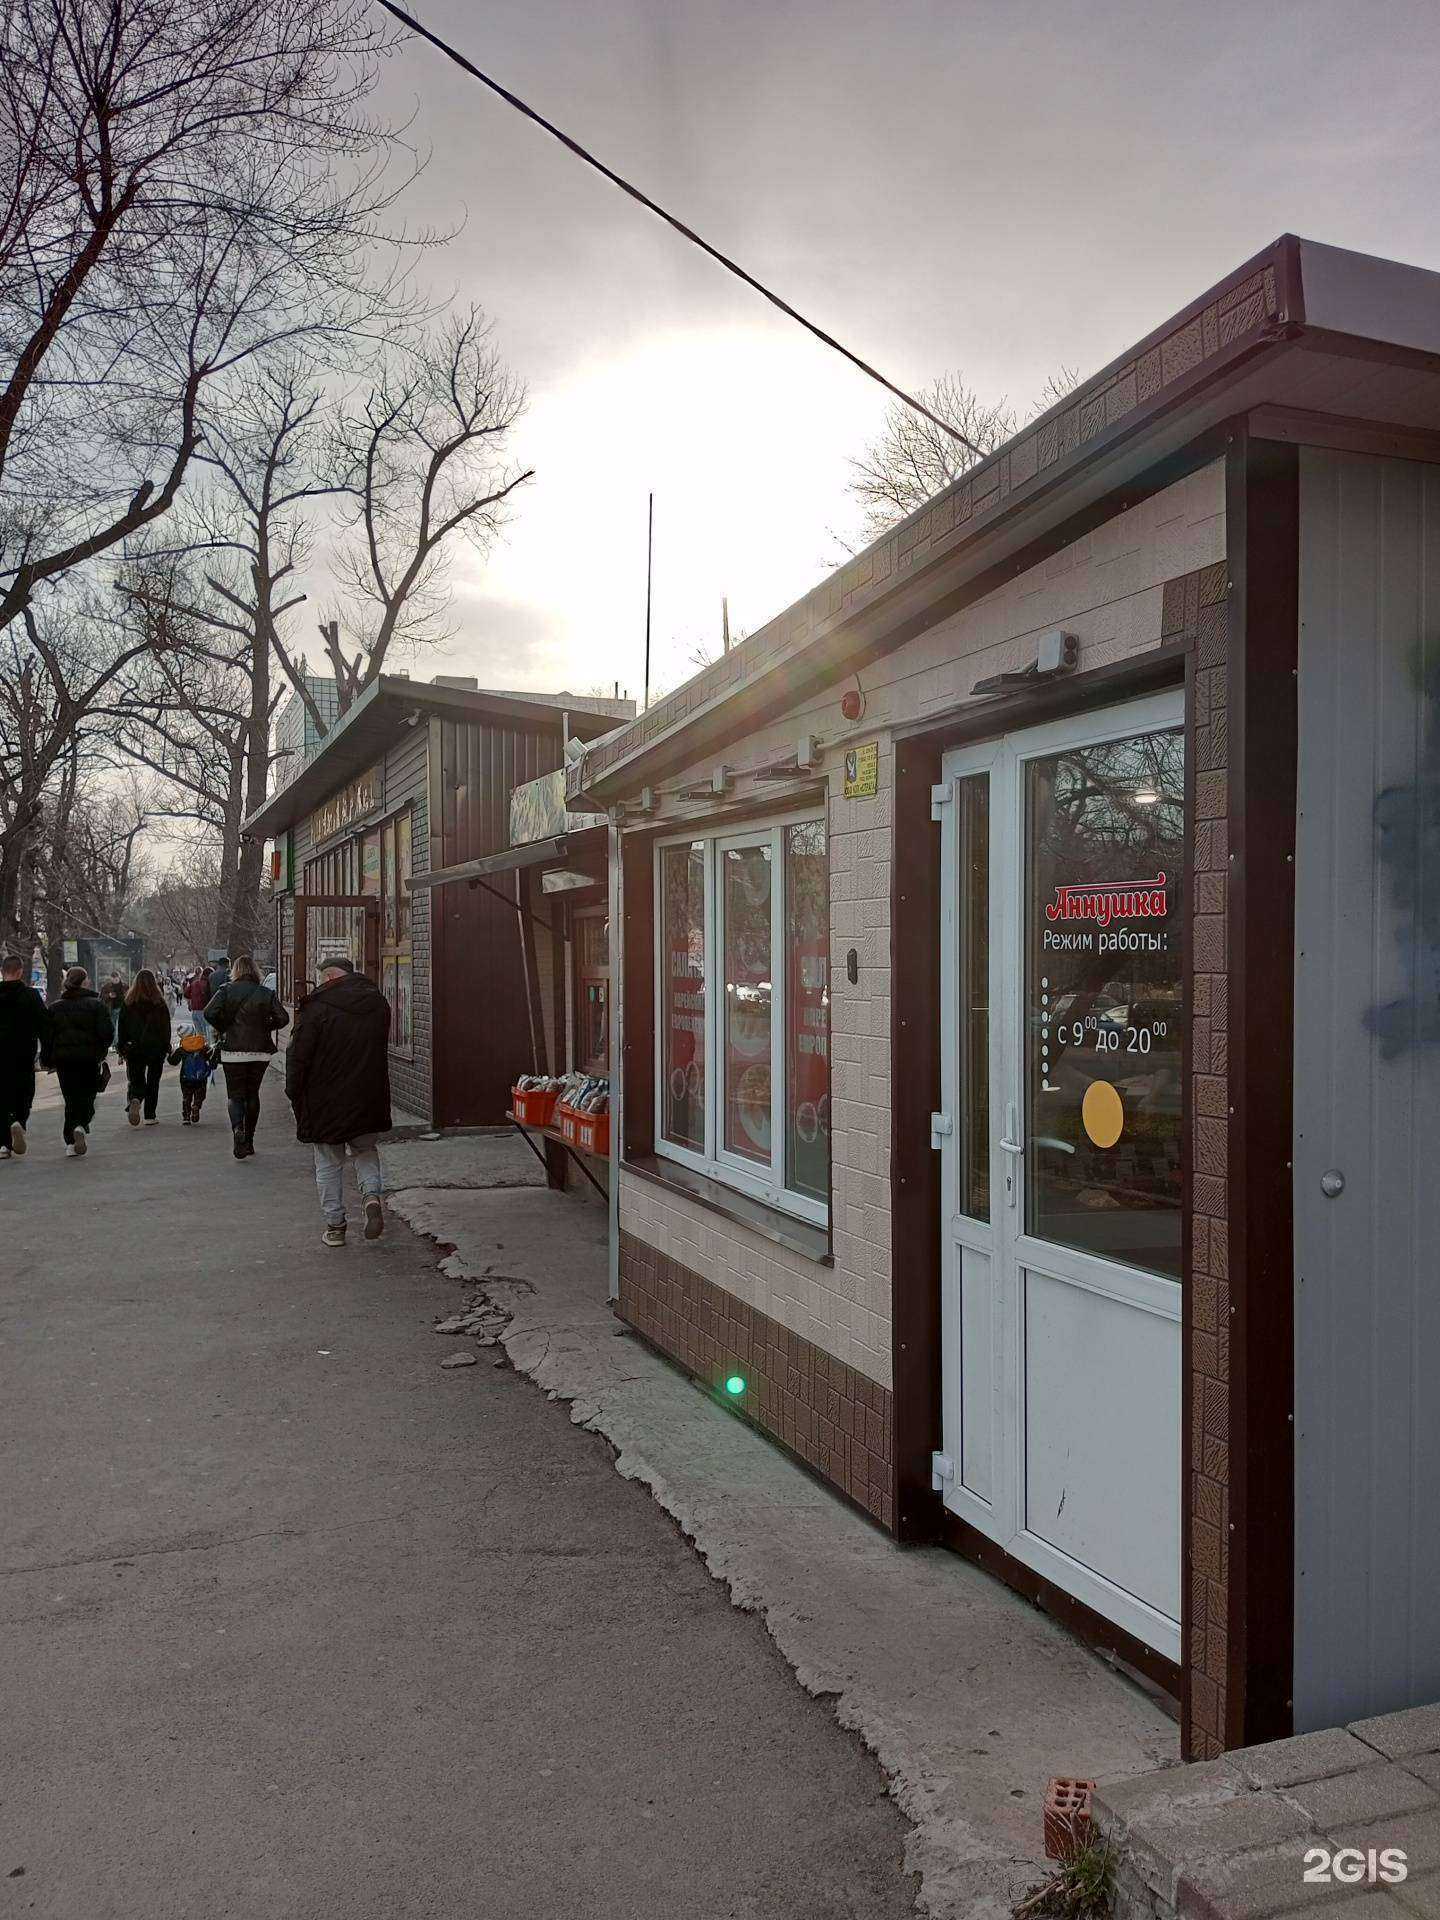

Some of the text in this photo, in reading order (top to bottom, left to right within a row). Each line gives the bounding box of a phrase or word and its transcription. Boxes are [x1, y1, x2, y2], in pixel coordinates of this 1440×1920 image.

[1046, 871, 1167, 926] Аннушка
[1043, 928, 1168, 955] Режим работы:
